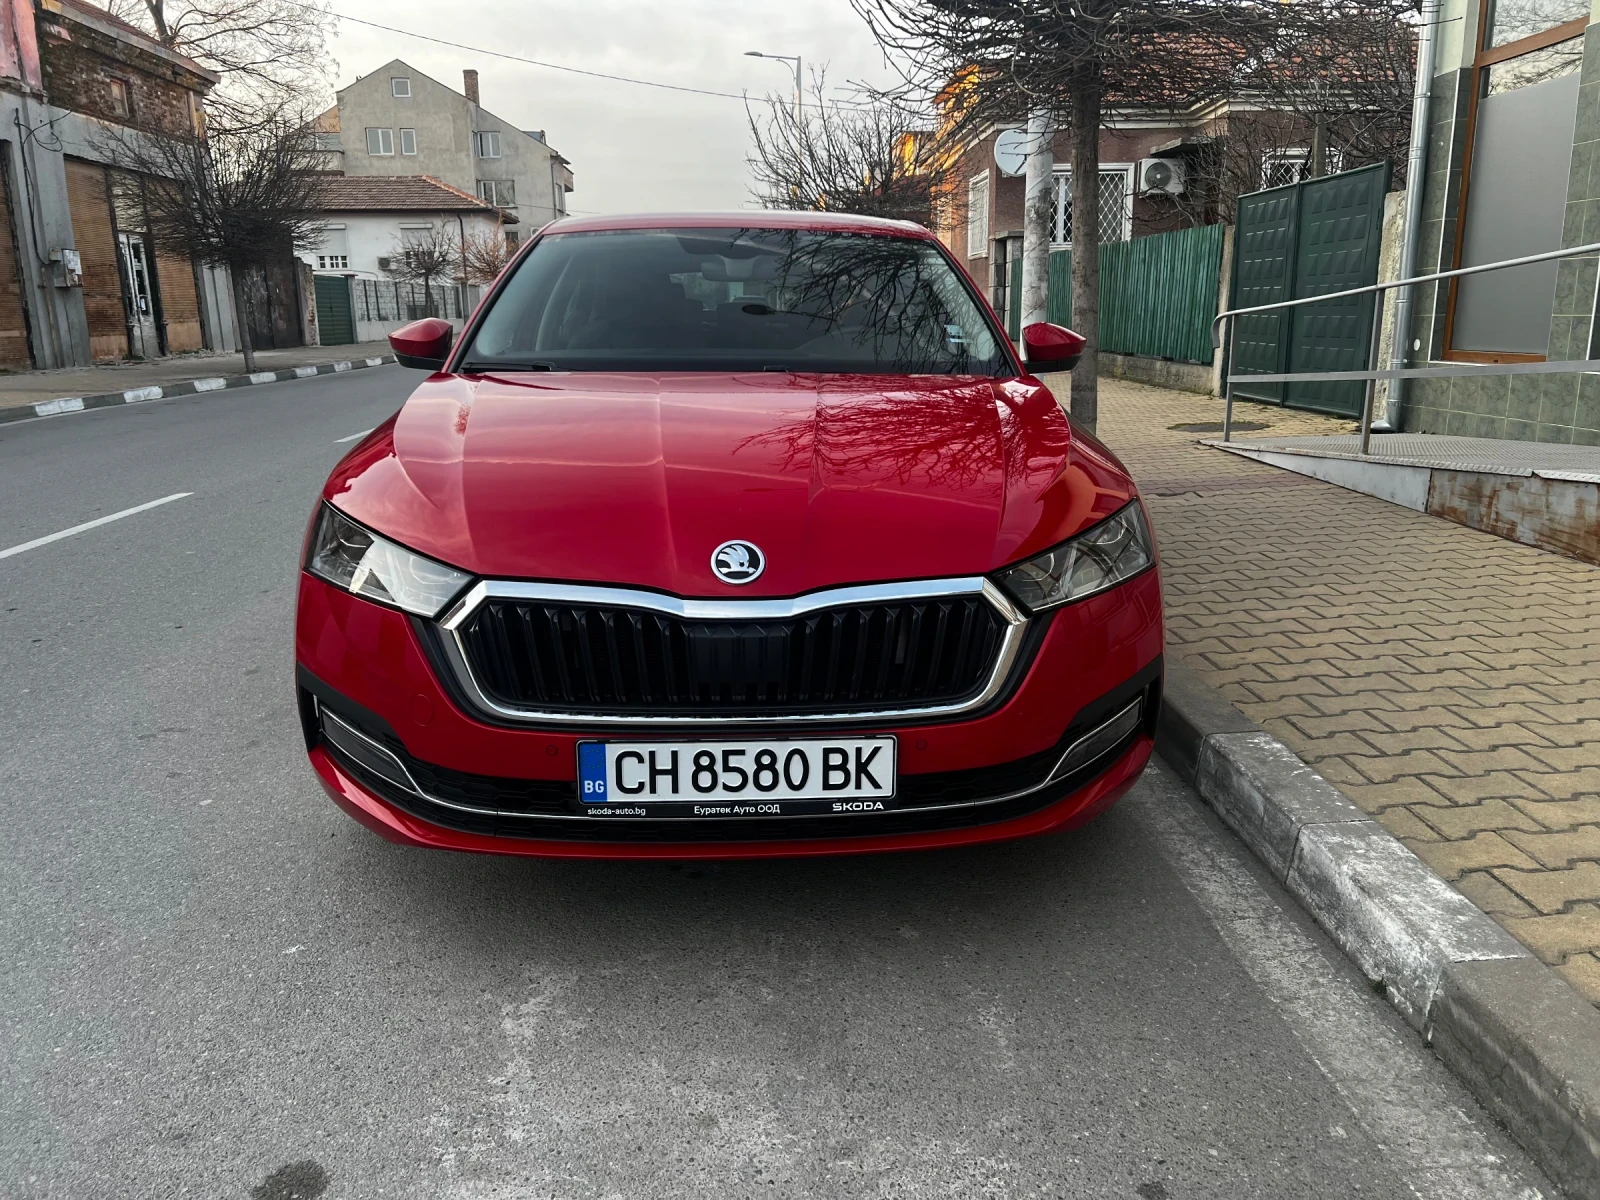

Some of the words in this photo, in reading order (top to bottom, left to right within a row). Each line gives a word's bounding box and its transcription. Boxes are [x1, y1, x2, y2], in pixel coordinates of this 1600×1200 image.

[615, 750, 678, 794] CH
[691, 748, 809, 794] 8580
[822, 746, 882, 791] BK
[584, 780, 605, 794] BG
[587, 807, 646, 816] skoda-auto.bg
[694, 806, 731, 816] Еуратек
[733, 805, 755, 815] Ауто
[757, 804, 781, 814] ООД
